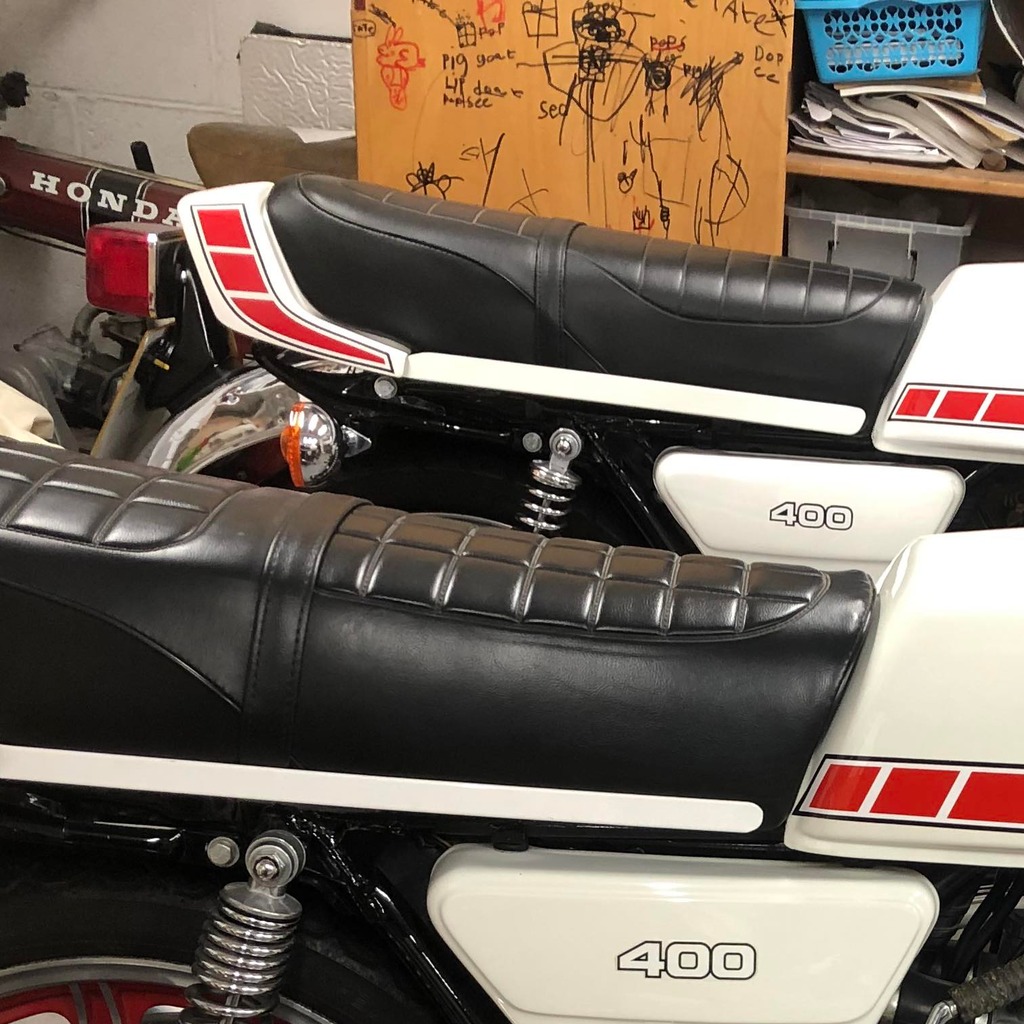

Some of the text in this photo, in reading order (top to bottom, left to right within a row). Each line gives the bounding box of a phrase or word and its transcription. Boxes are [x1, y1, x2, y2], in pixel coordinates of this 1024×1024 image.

[30, 171, 182, 226] HONDA
[769, 501, 853, 530] 400
[617, 941, 756, 980] 400
